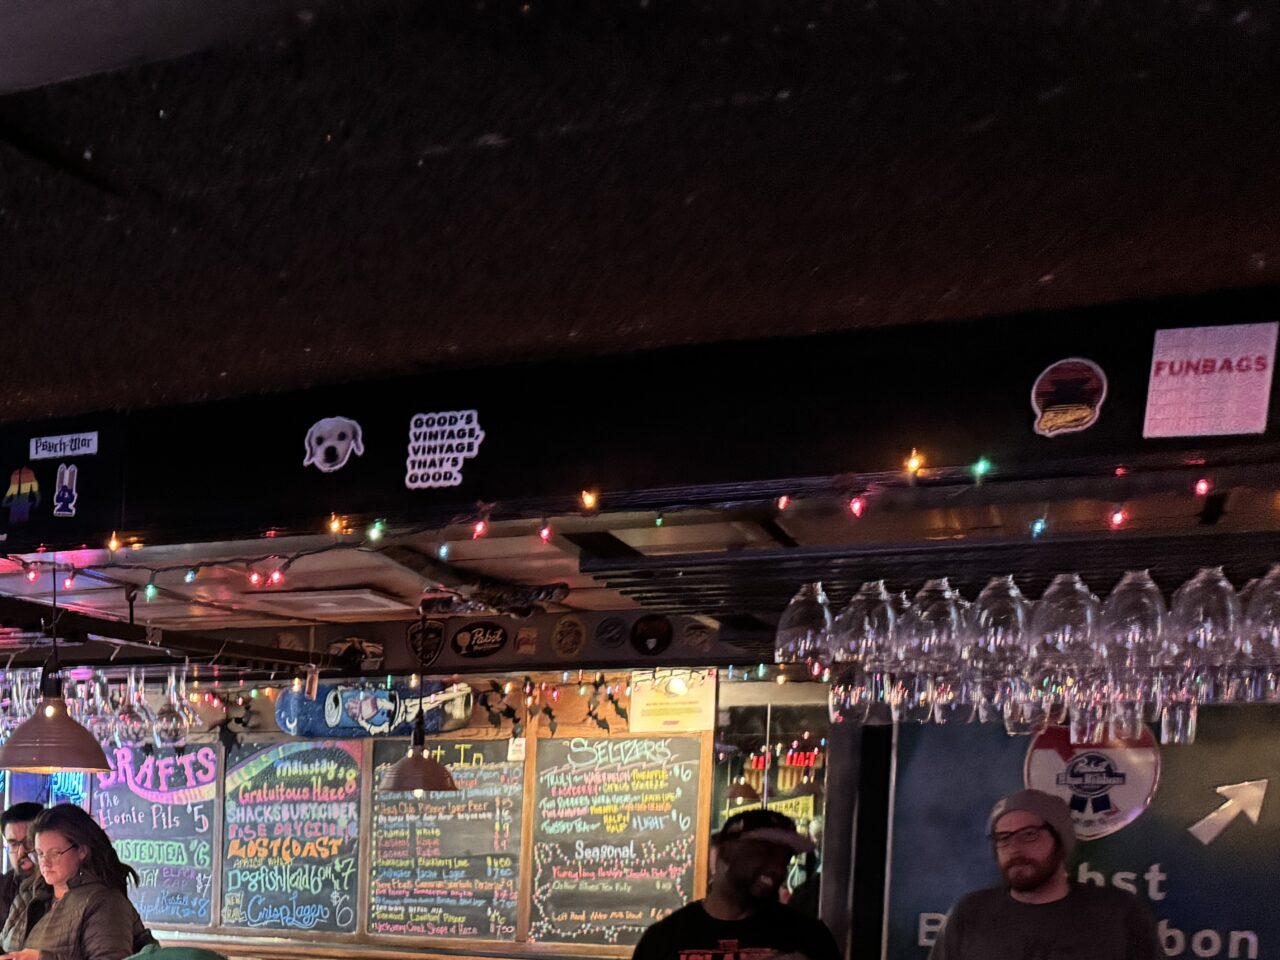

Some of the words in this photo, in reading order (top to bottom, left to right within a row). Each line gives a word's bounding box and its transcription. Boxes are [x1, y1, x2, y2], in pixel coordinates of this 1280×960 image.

[1154, 355, 1268, 377] FUNBAGS
[413, 413, 473, 428] GOOD'S
[412, 428, 480, 442] VINTAGE,
[411, 442, 474, 456] VINTAGE
[409, 457, 459, 470] THAT'S
[408, 471, 457, 484] GOOD.
[471, 627, 503, 645] Pabst
[94, 790, 120, 808] The
[239, 781, 309, 804] Gratuitous
[311, 776, 345, 802] Haze
[151, 804, 180, 830] Pils
[575, 839, 636, 860] Seasonal
[1078, 862, 1168, 901] bst
[1158, 919, 1259, 960] bon
